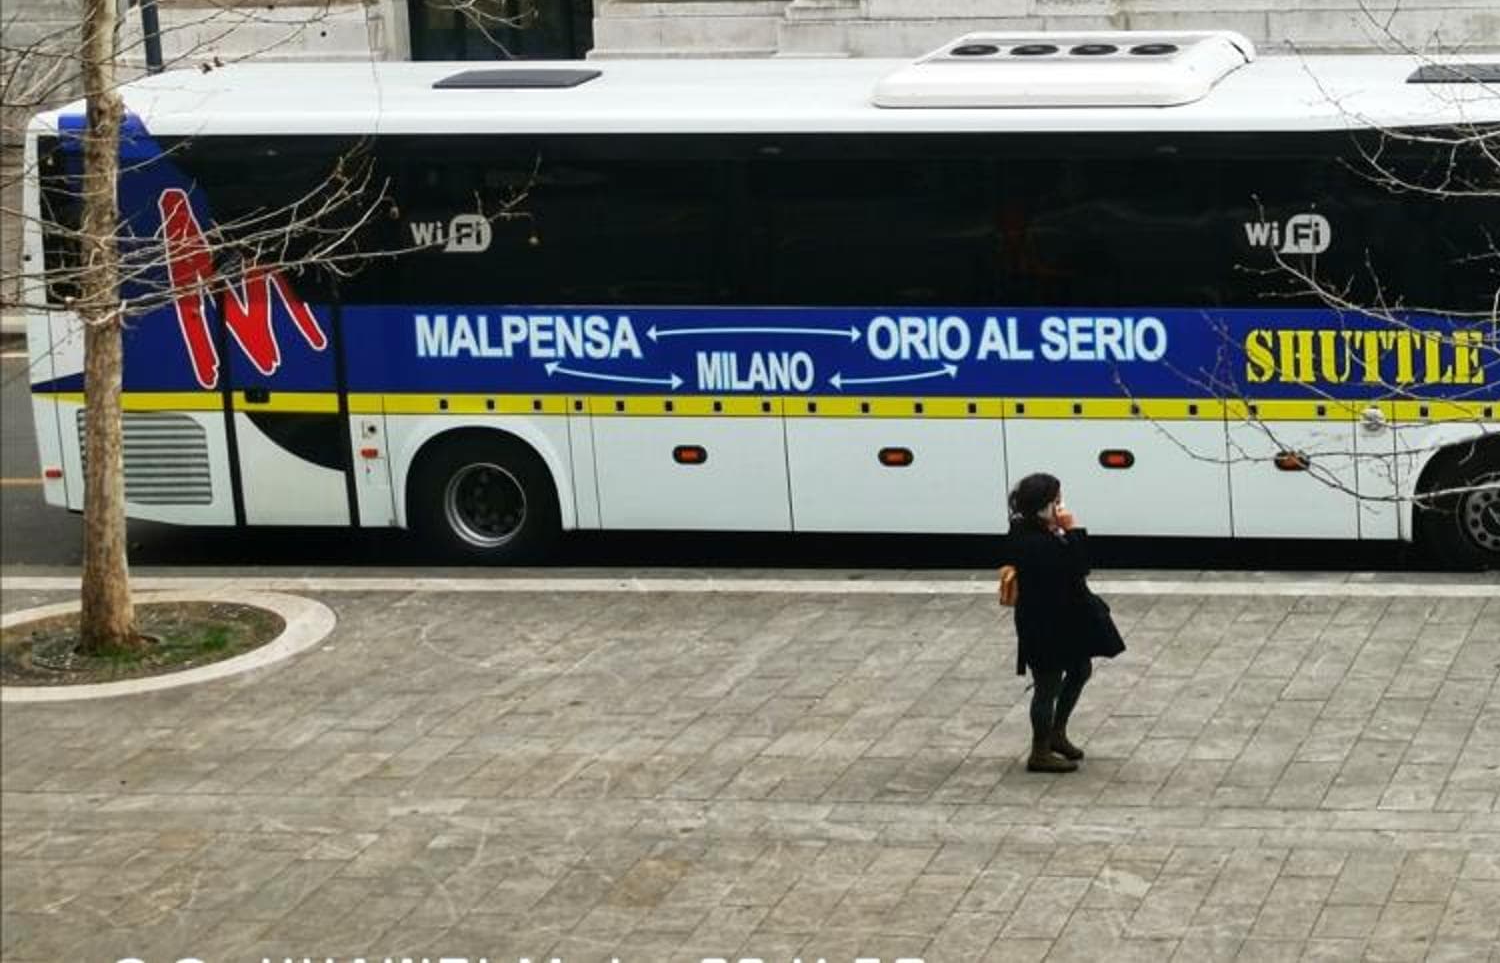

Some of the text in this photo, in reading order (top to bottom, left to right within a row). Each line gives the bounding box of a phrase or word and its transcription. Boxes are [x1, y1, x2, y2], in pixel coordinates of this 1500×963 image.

[415, 316, 1167, 362] MALPENSA ORIO AL SERIO
[1245, 330, 1484, 384] SHUTTLE
[697, 350, 814, 391] MILANO
